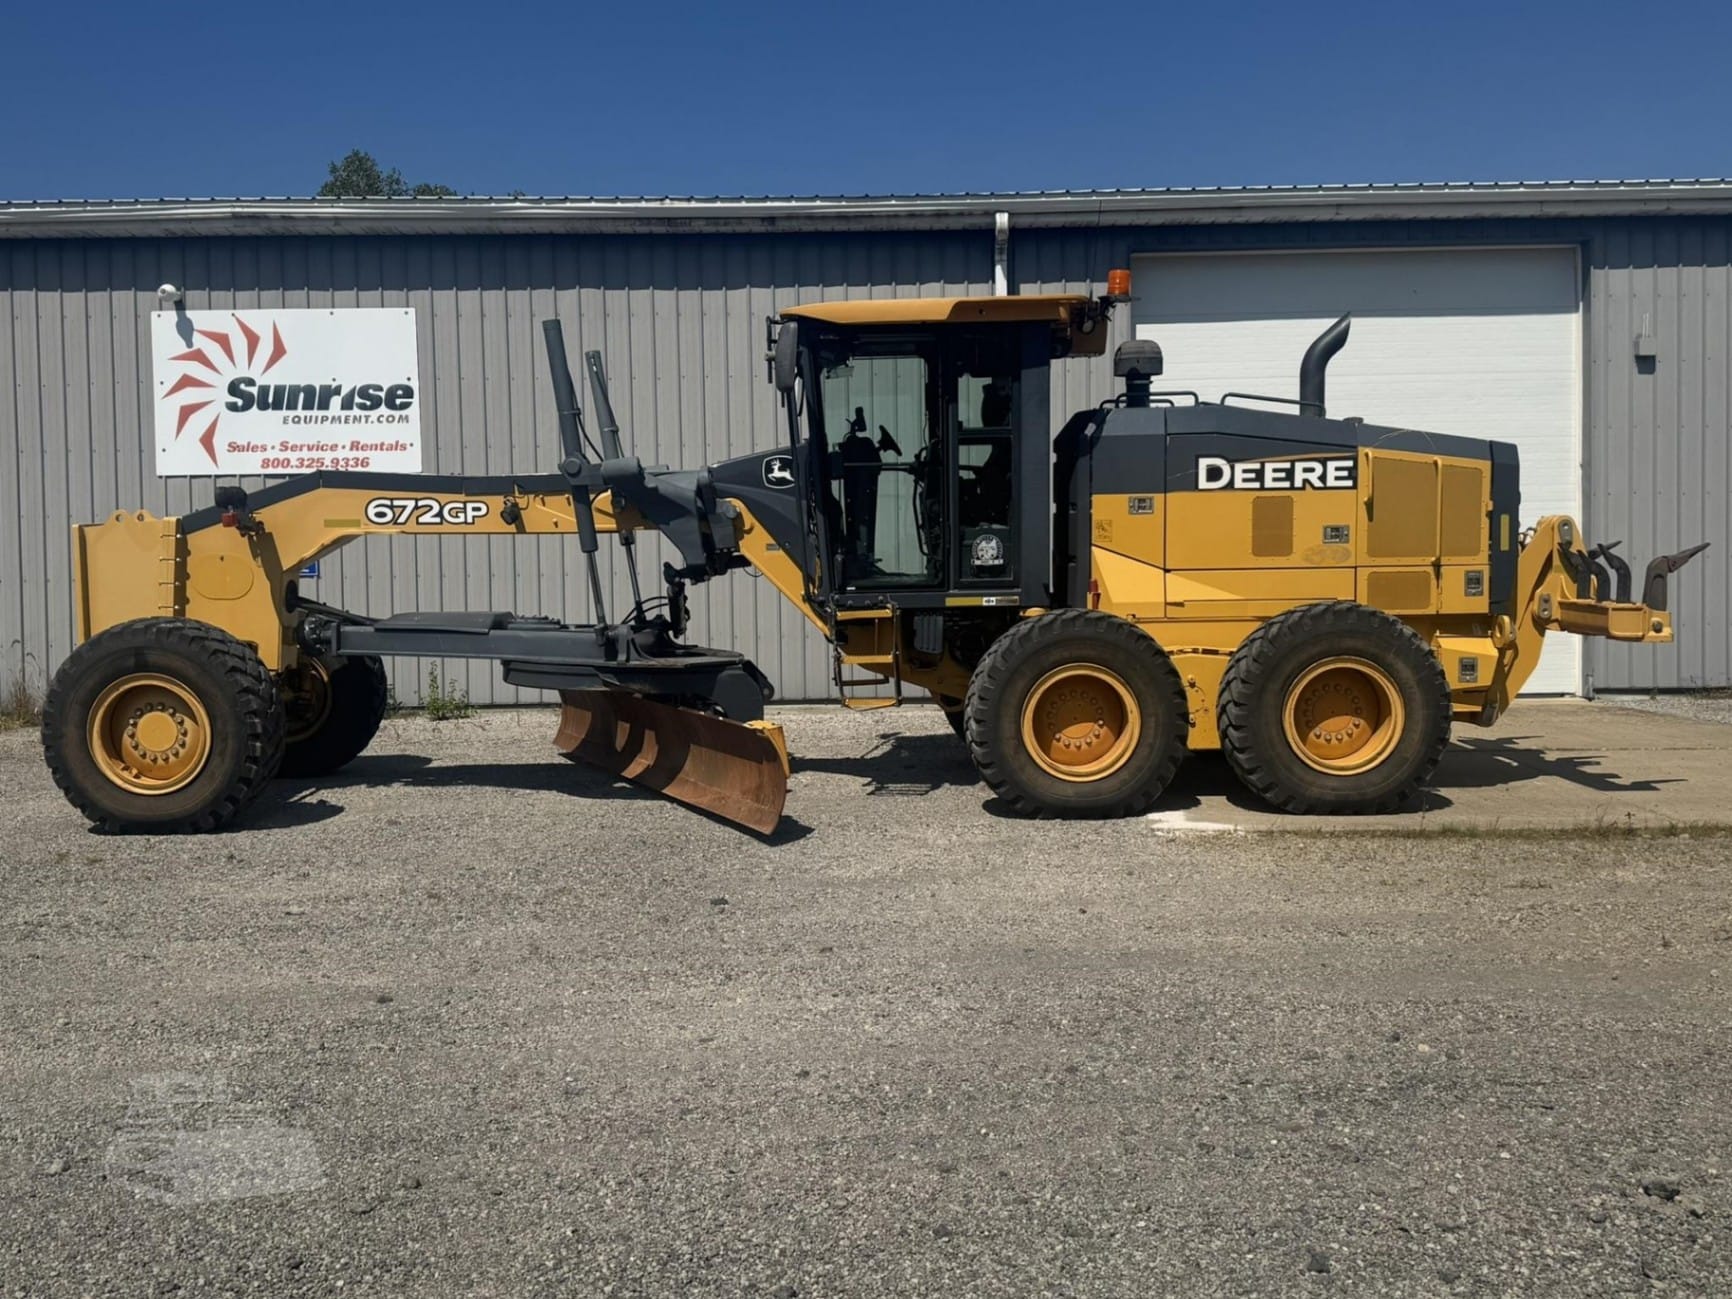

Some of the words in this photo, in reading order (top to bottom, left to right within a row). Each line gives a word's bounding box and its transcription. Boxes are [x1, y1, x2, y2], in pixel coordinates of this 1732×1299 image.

[225, 376, 414, 413] Sunrise
[282, 414, 410, 425] EQUIPMENT.COM
[226, 441, 268, 453] Sales
[279, 440, 339, 452] Service
[349, 439, 408, 452] Rentals
[260, 456, 371, 470] 800.325.9336
[1198, 457, 1354, 490] DEERE
[366, 497, 489, 525] 672GP
